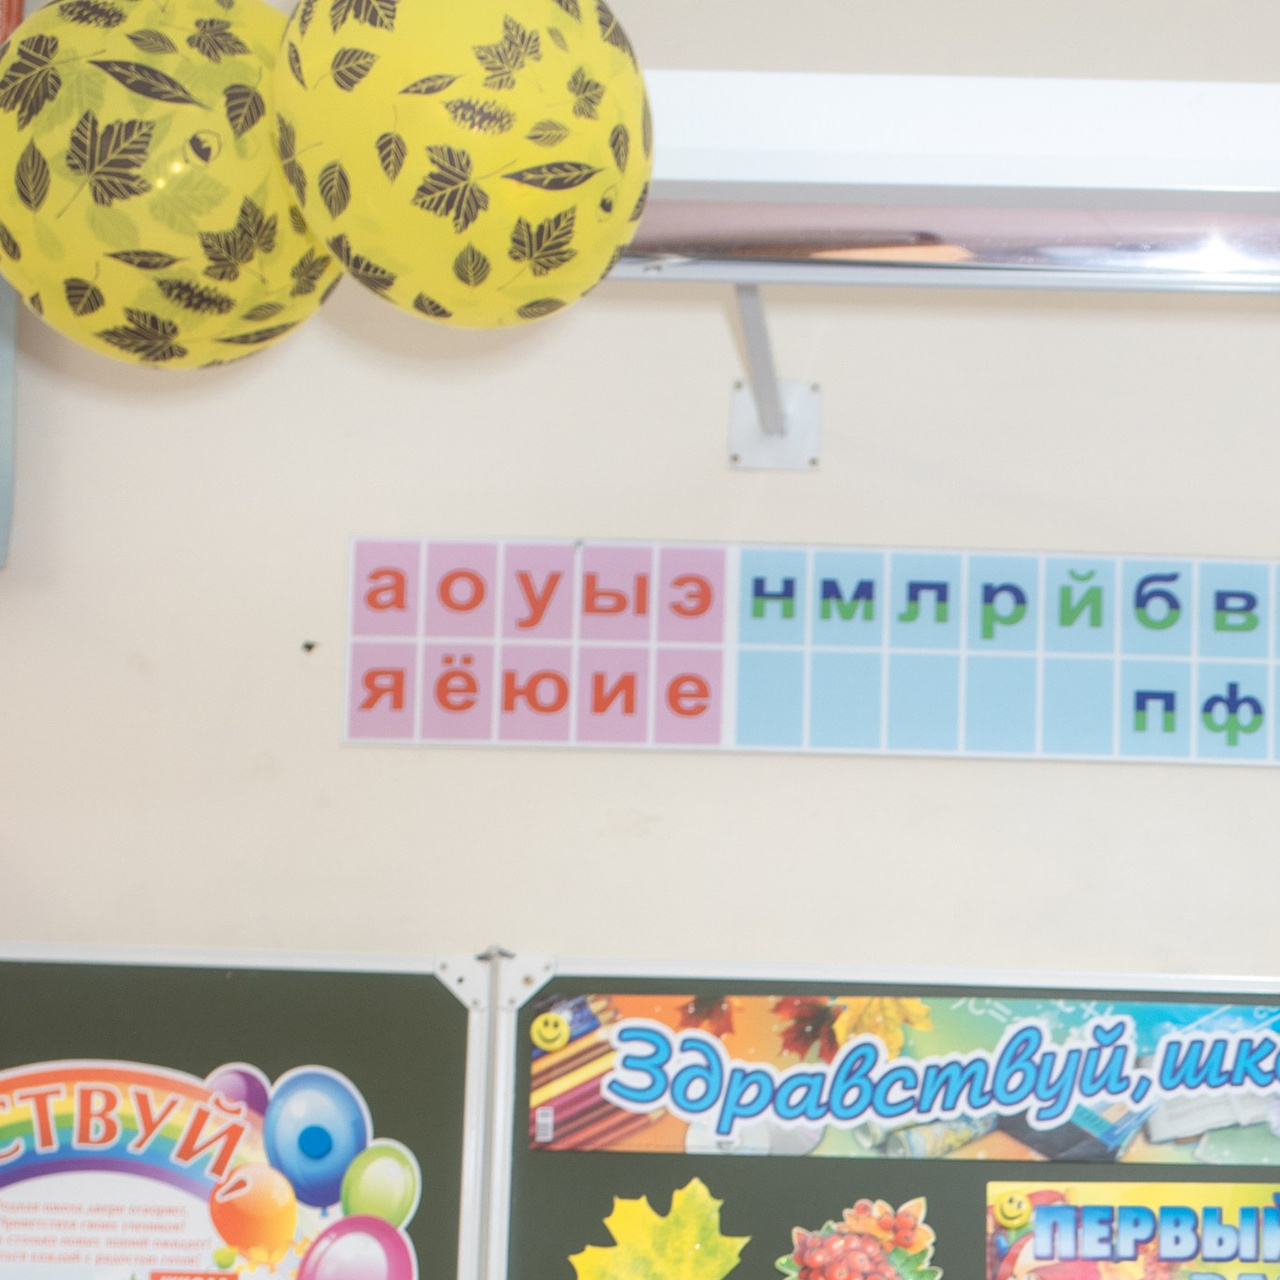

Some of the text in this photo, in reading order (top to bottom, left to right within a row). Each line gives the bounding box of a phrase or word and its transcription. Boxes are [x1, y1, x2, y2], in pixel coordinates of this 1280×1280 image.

[365, 567, 407, 610] а
[438, 570, 486, 611] о
[516, 570, 562, 628] у
[582, 574, 649, 615] ы
[670, 575, 713, 617] э
[753, 577, 795, 619] н
[820, 579, 875, 621] м
[898, 582, 948, 622] л
[981, 582, 1026, 639] р
[1059, 570, 1102, 627] й
[1135, 572, 1181, 630] б
[1215, 591, 1258, 633] в
[359, 668, 404, 710] я
[435, 654, 477, 712] ё
[503, 670, 569, 714] ю
[593, 673, 636, 715] и
[668, 674, 711, 717] е
[1134, 691, 1175, 732] п
[1203, 684, 1264, 746] ф
[606, 1021, 1151, 1136] Здравствуй,
